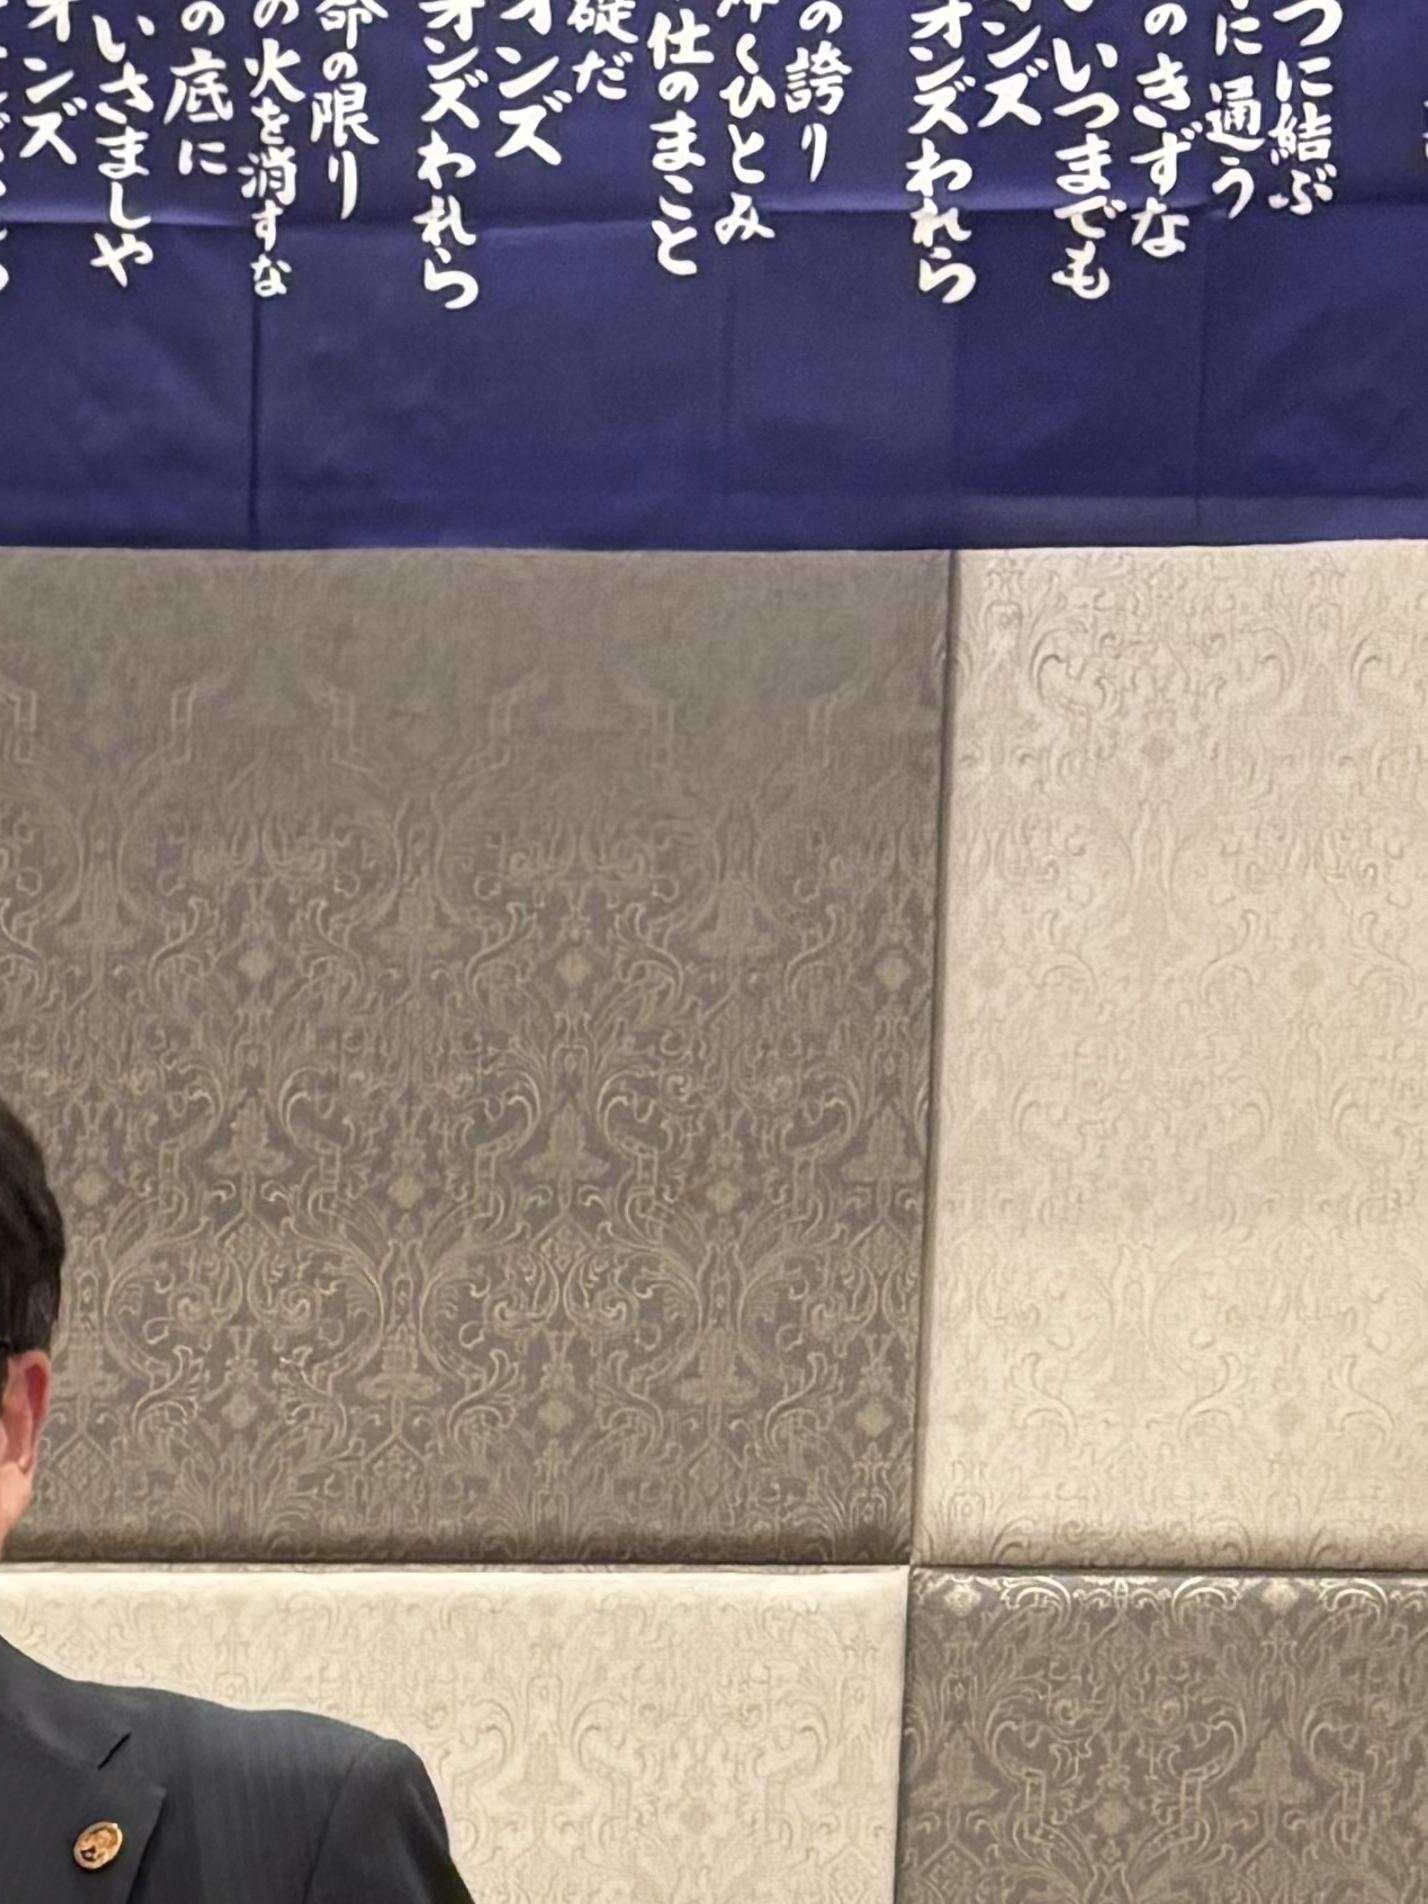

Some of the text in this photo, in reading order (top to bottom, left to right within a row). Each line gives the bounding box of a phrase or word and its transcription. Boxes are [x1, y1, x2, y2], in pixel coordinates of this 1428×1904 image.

[163, 0, 234, 175] の底に
[238, 0, 306, 297] の火を消すな
[310, 0, 389, 219] 命の限り
[784, 0, 853, 182] の誇り
[905, 0, 977, 304] オンズわれら
[977, 0, 1049, 128] ンズ
[1051, 0, 1127, 300] いつまでも
[1130, 2, 1204, 258] のきずな
[1204, 0, 1266, 219] に通う
